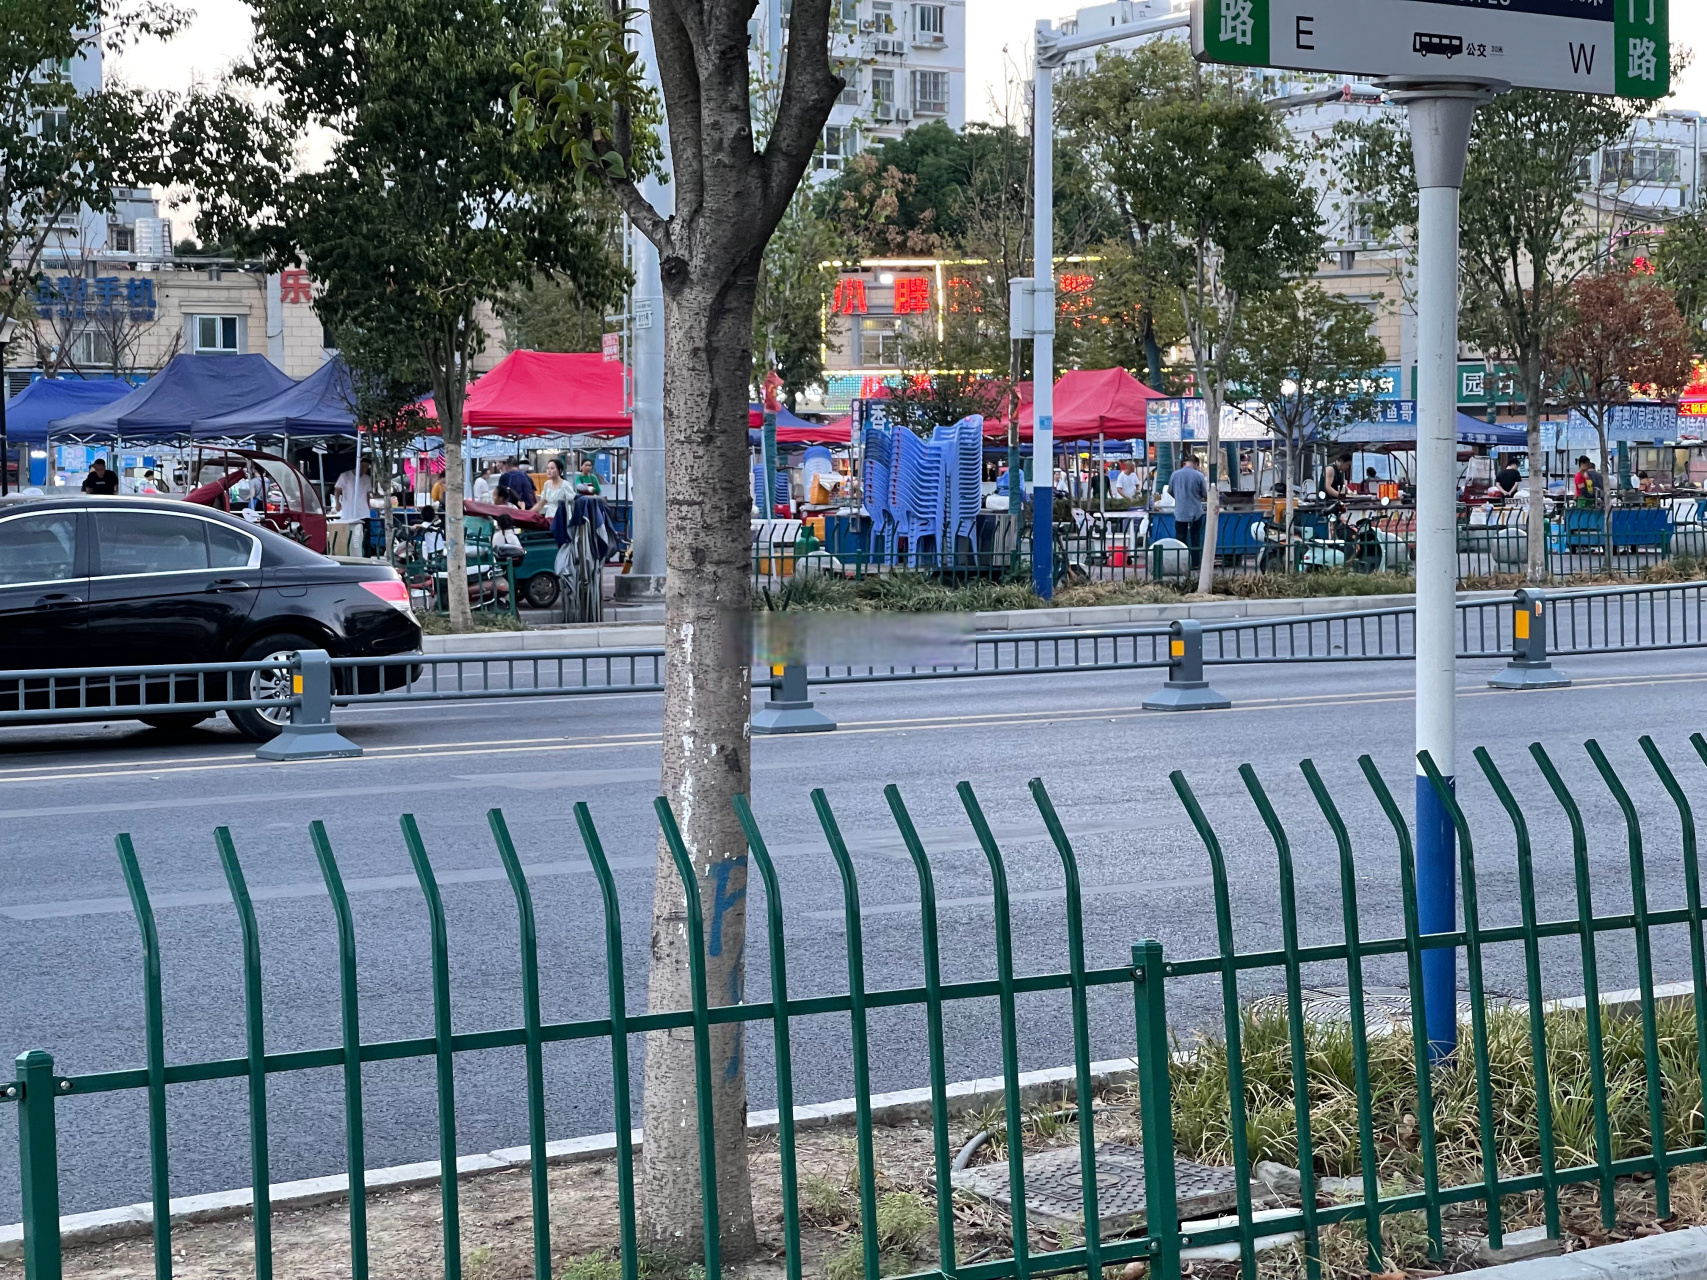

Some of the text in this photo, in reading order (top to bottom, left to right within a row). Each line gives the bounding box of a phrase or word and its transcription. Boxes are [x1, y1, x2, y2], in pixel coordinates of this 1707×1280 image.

[1219, 0, 1254, 45] 路
[1296, 16, 1315, 50] E
[1466, 42, 1487, 58] 公交
[1569, 42, 1596, 75] W
[280, 270, 312, 304] 乐
